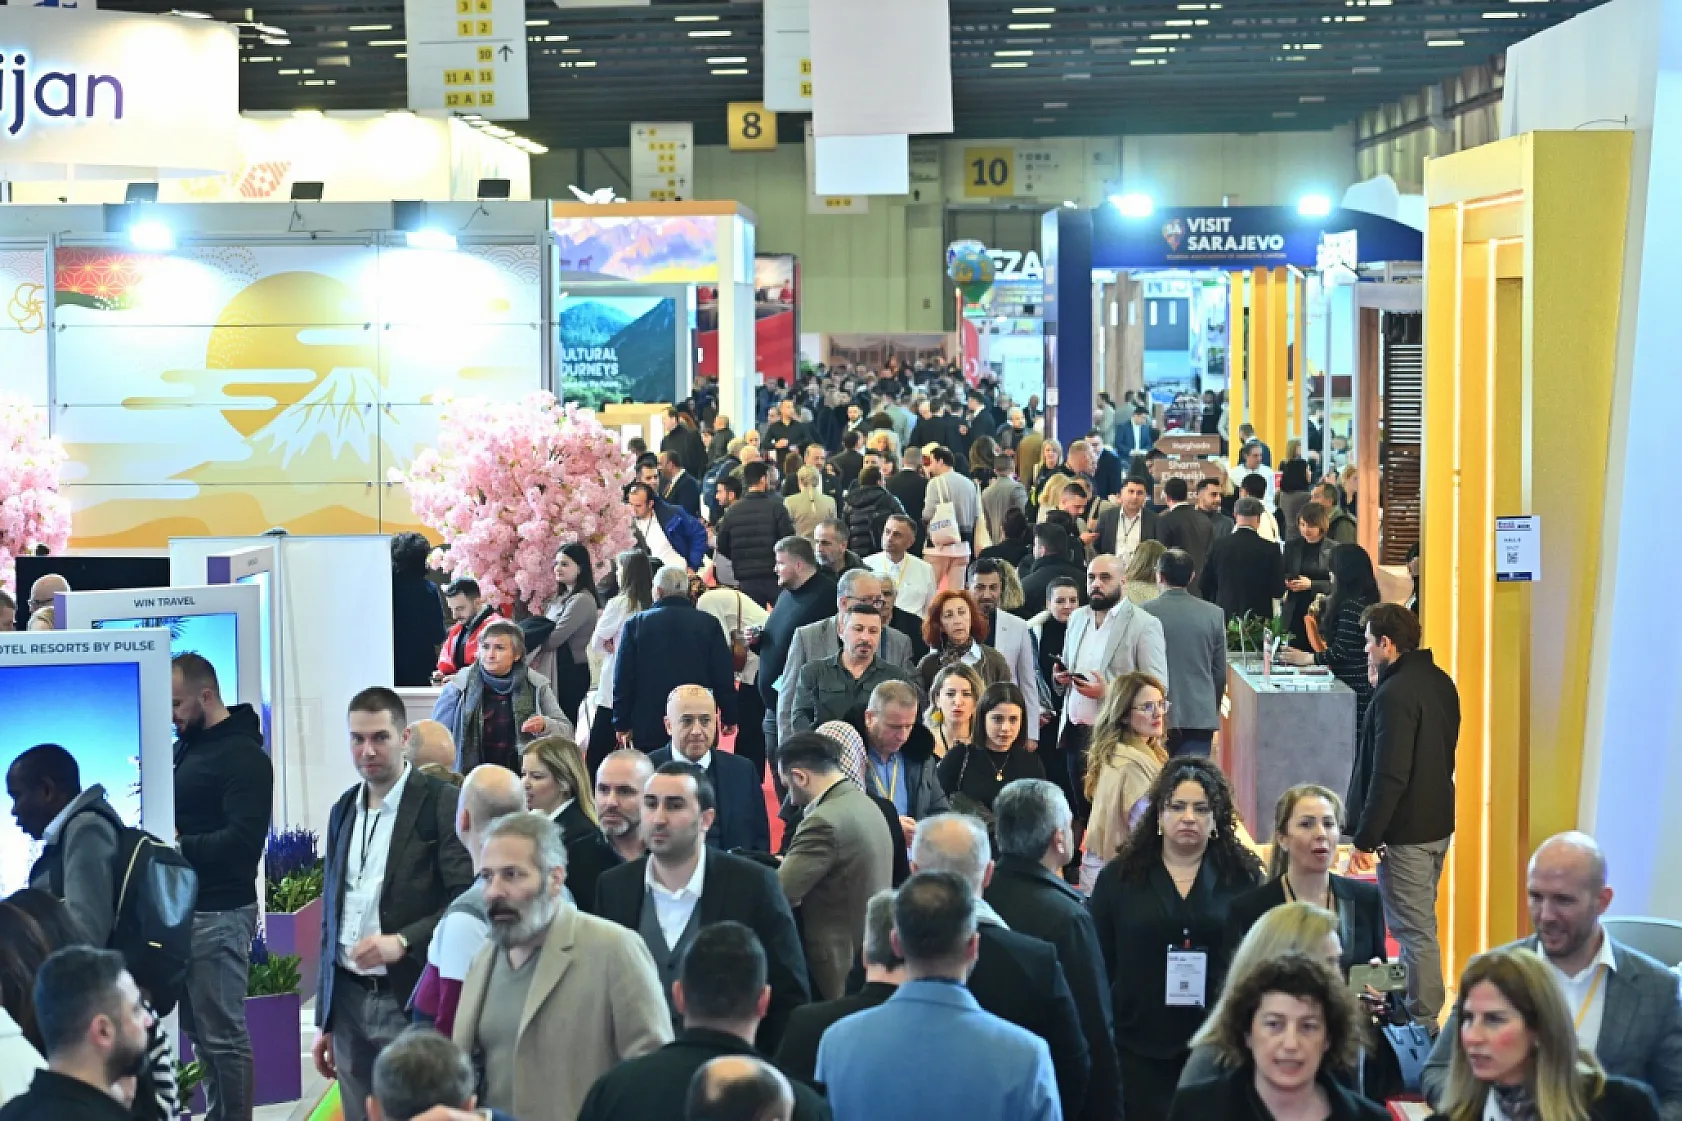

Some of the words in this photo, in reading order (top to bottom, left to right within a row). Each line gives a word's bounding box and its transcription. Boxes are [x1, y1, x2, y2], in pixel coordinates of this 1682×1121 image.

[463, 23, 468, 34] 1
[481, 22, 487, 33] 2
[479, 49, 492, 60] 10
[446, 72, 457, 83] 11
[464, 72, 471, 82] A
[480, 71, 491, 82] 11
[447, 95, 458, 105] 12
[465, 94, 472, 104] A
[482, 93, 493, 104] 12
[742, 112, 762, 140] 8
[971, 157, 1009, 186] 10
[1187, 217, 1232, 233] VISIT
[1187, 234, 1285, 251] SARAJEVO
[1169, 460, 1200, 470] Sharm
[134, 598, 155, 608] WIN
[158, 596, 196, 607] TRAVEL
[31, 641, 90, 654] RESORTS
[93, 641, 110, 652] BY
[114, 640, 155, 651] PULSE
